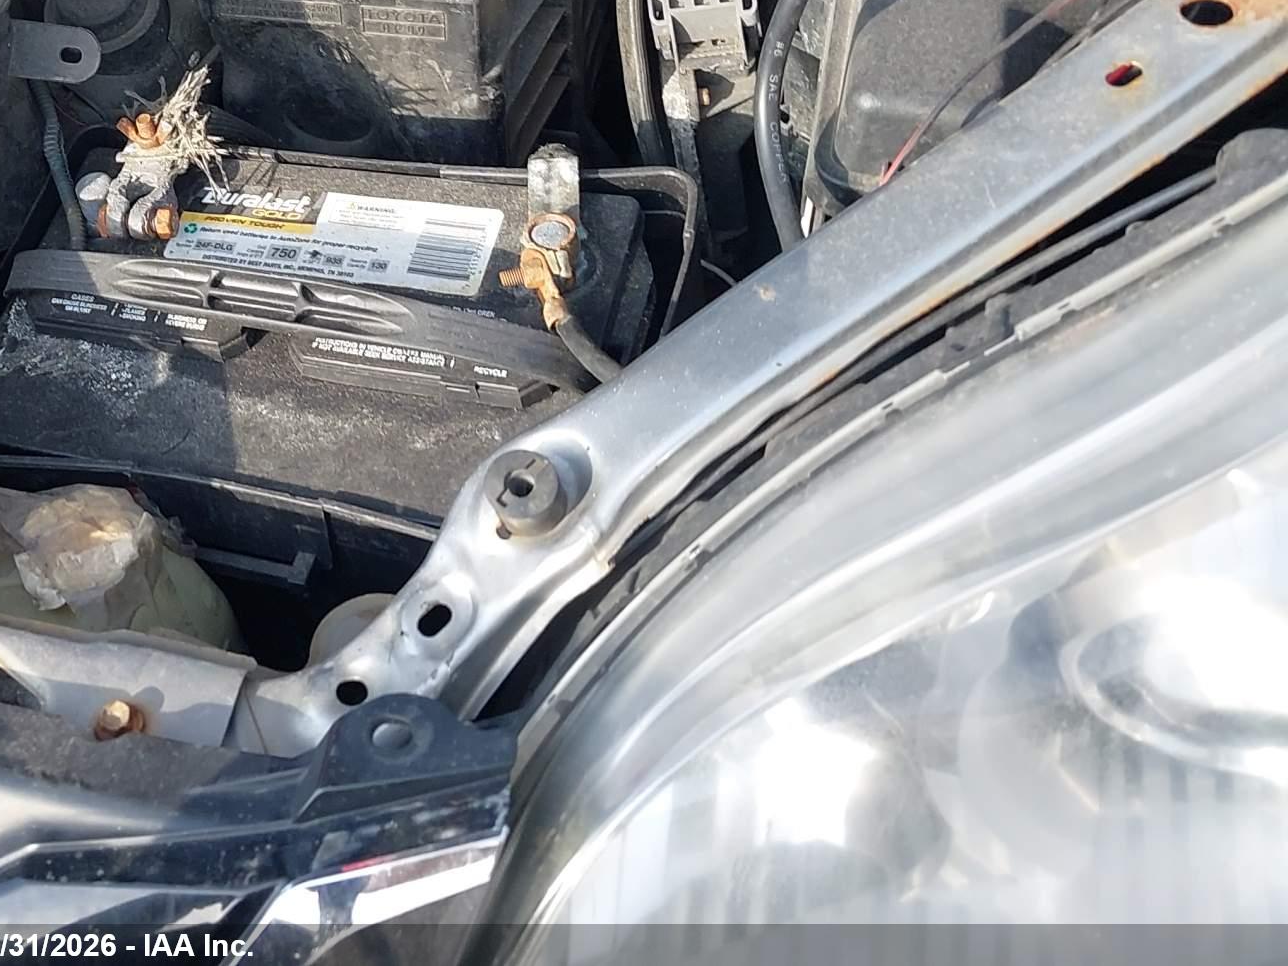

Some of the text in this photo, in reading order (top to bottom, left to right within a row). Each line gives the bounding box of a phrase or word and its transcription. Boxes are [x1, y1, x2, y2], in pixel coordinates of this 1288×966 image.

[367, 9, 441, 24] TOYOTA
[768, 74, 779, 102] SAE
[201, 186, 312, 214] Duralast
[252, 208, 302, 220] GOLD
[249, 220, 284, 230] TOUGH
[195, 241, 233, 251] 24F-DLG
[279, 235, 311, 244] AutoZone
[322, 240, 346, 249] proper
[272, 247, 297, 259] 750
[202, 254, 238, 264] DISTRIBUTED
[247, 259, 262, 267] BEST
[71, 293, 96, 303] GASES
[316, 337, 358, 349] INSTRUCTIONS
[367, 343, 392, 354] VEHICLE
[420, 351, 446, 361] MANUAL
[332, 345, 364, 357] AVAILABLE
[381, 351, 407, 363] SERVICE
[407, 355, 446, 367] ASSISTANCE
[474, 365, 508, 378] RECYCLE
